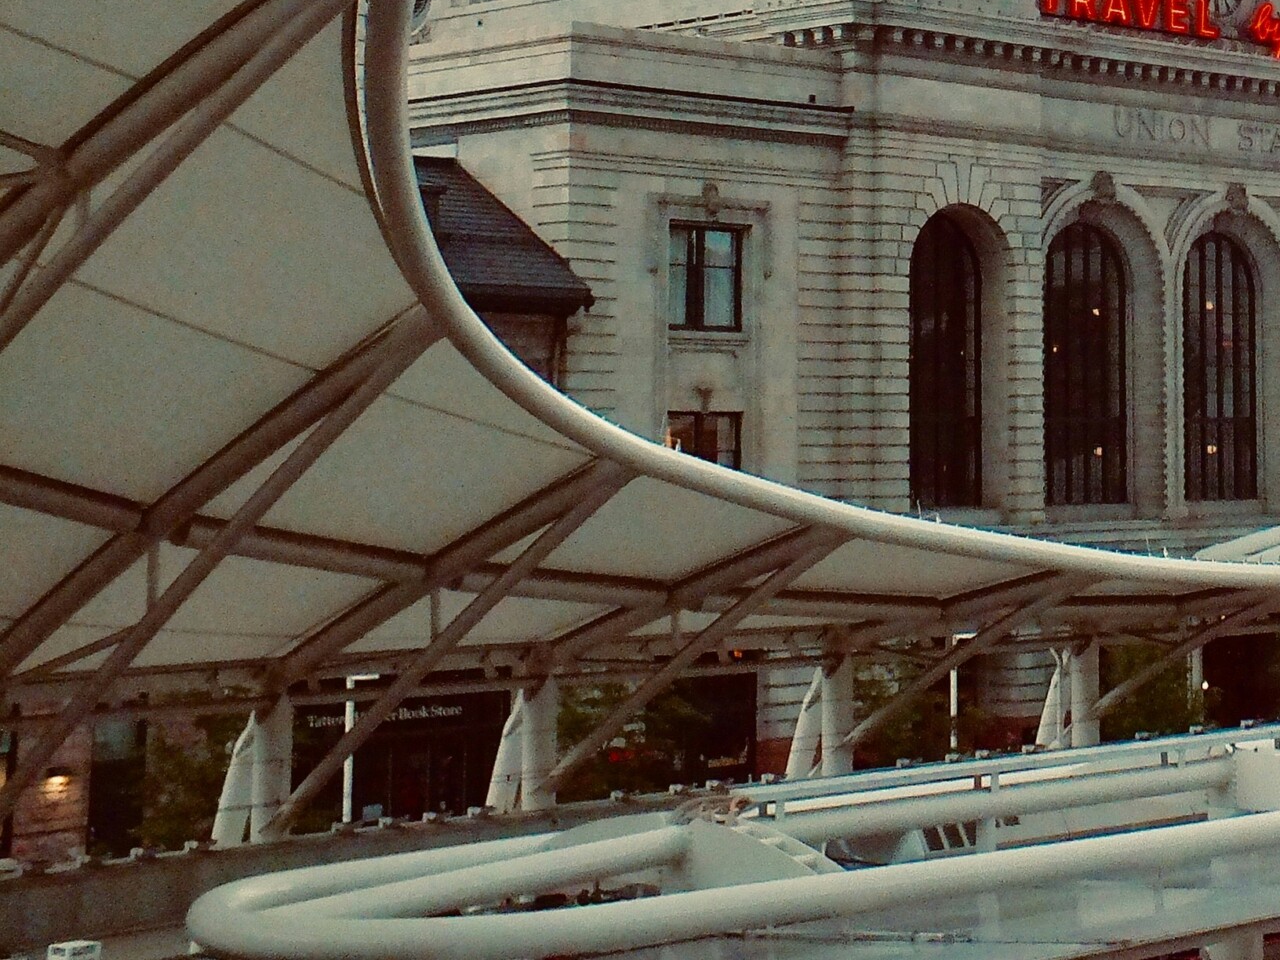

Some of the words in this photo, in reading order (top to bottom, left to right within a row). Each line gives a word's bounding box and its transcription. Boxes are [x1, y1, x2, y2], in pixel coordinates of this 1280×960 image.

[1112, 105, 1211, 151] UNION
[398, 705, 429, 721] Book
[431, 703, 463, 718] Store
